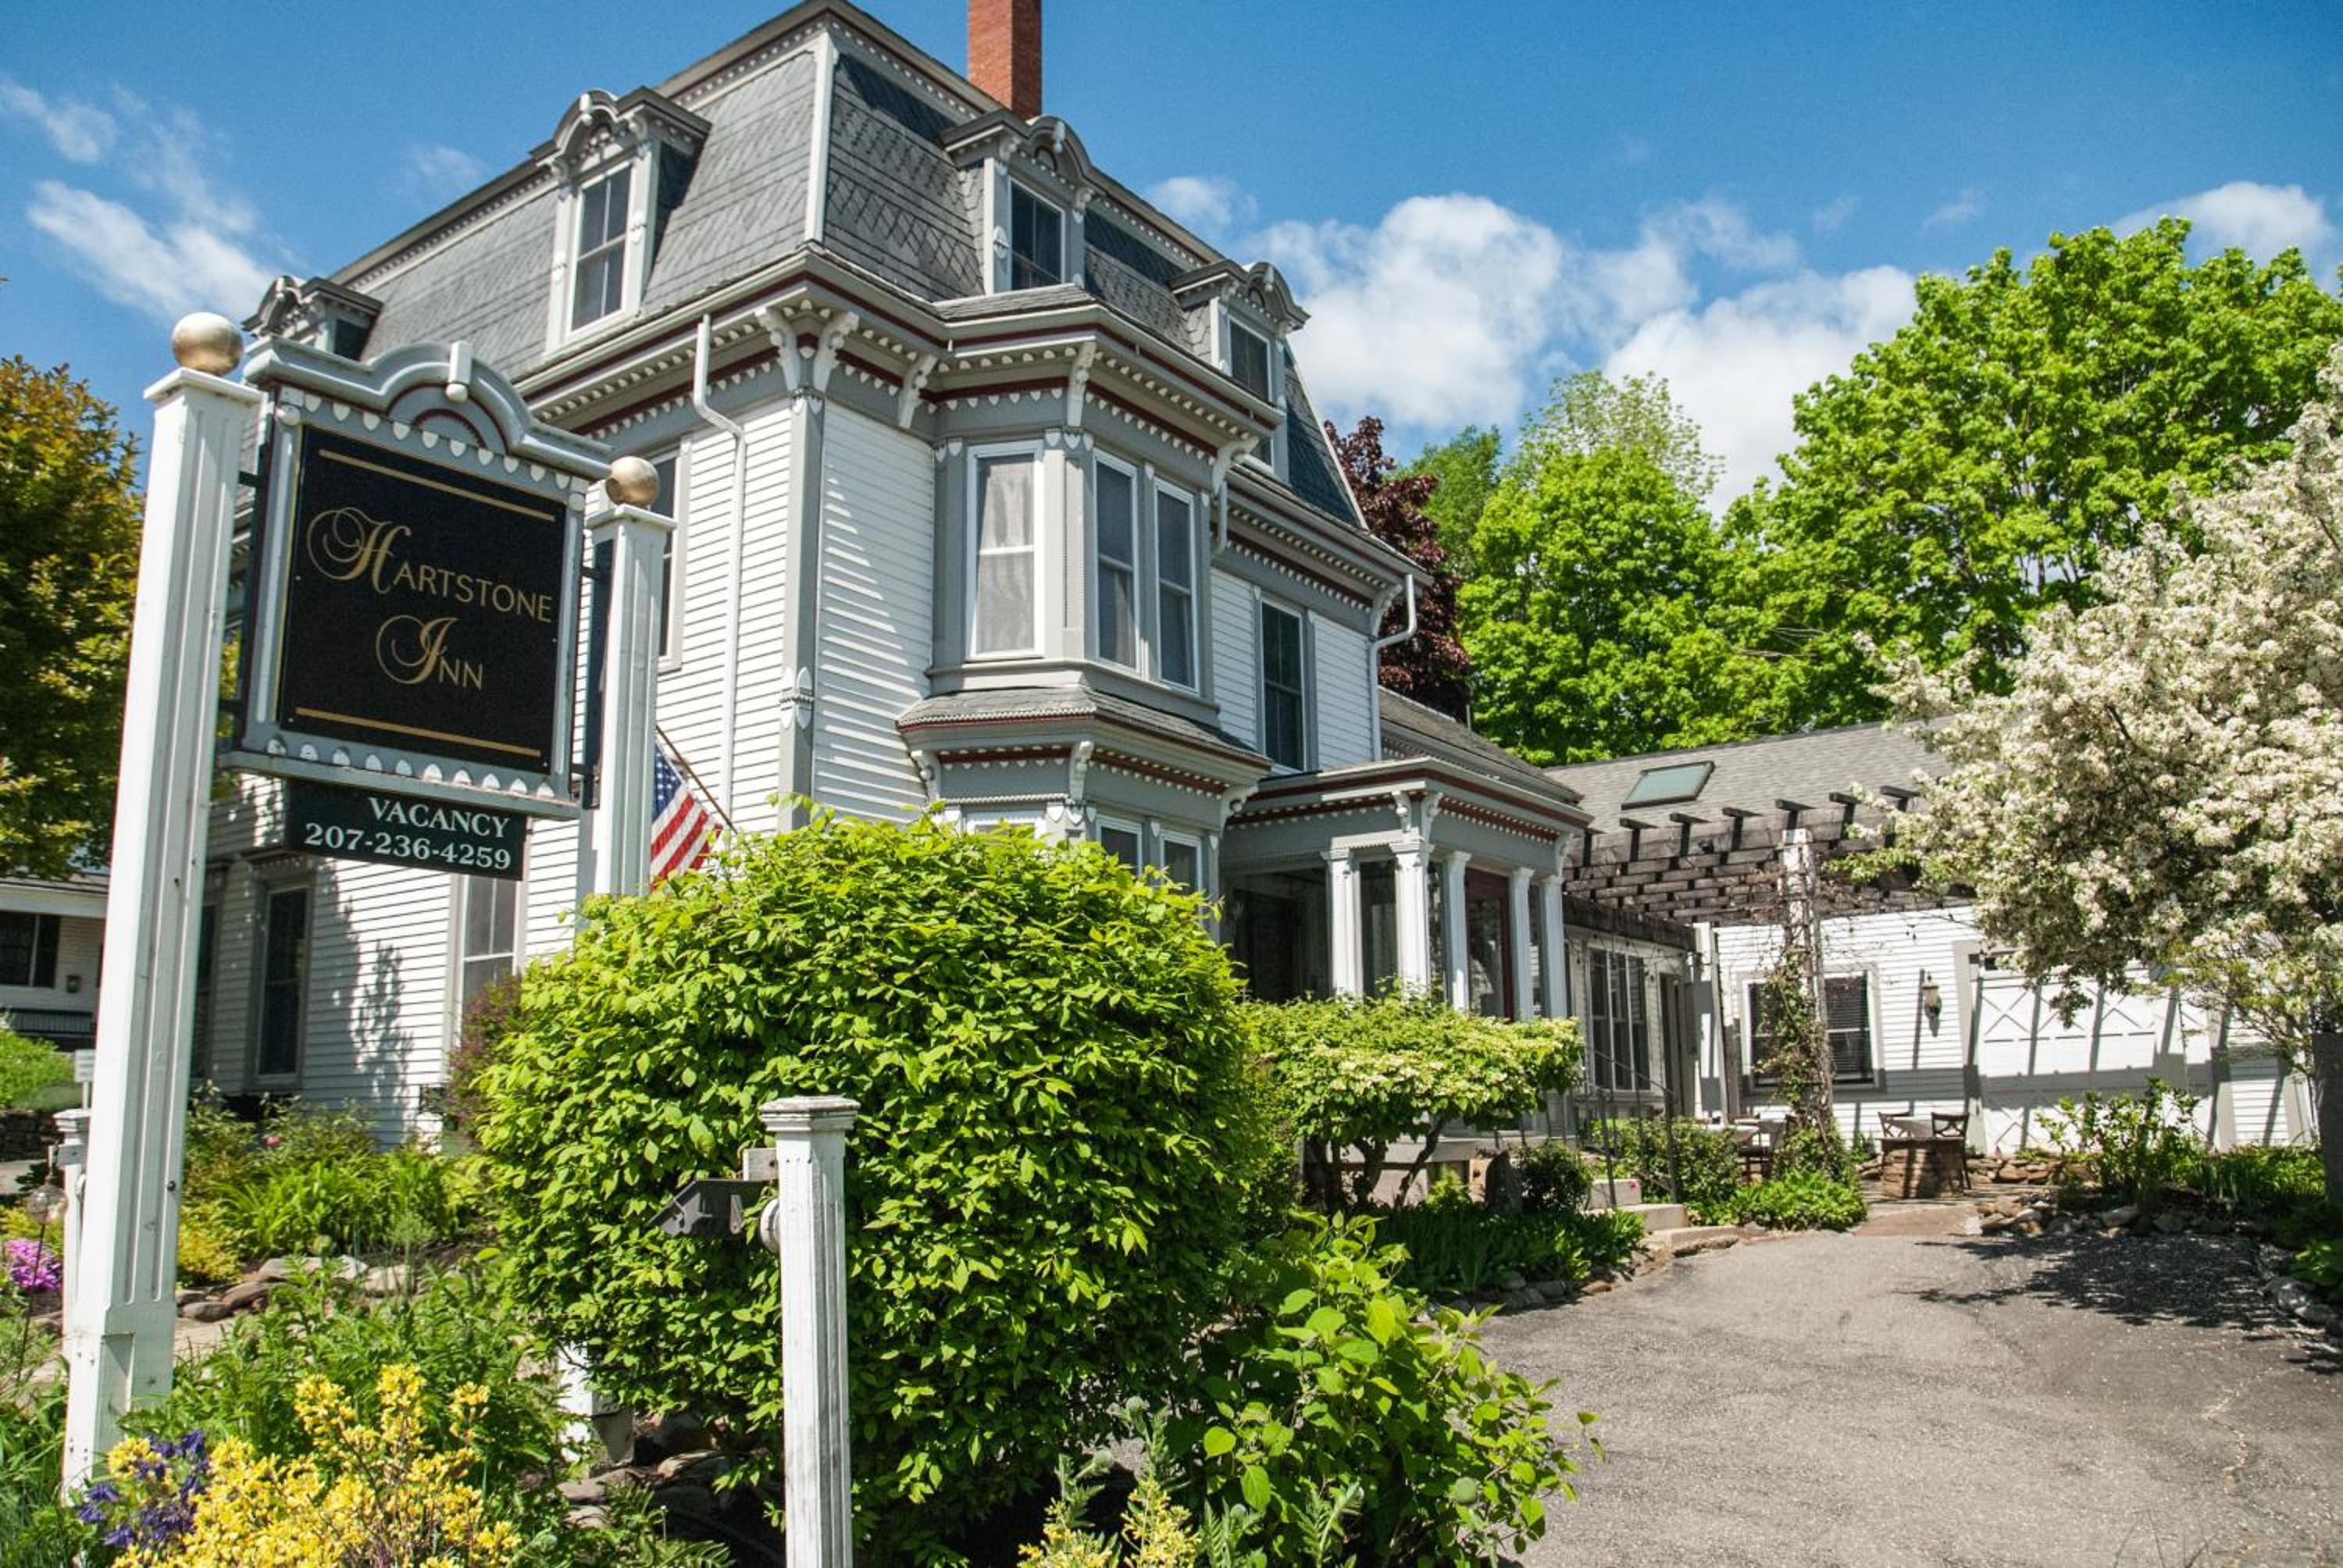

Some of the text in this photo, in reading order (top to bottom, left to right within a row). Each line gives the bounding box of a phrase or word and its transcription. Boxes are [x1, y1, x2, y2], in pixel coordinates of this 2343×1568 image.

[307, 508, 552, 623] HARTSTONE
[376, 615, 484, 690] INN
[304, 822, 512, 870] 207-236-4259
[369, 797, 509, 838] VACANCY
